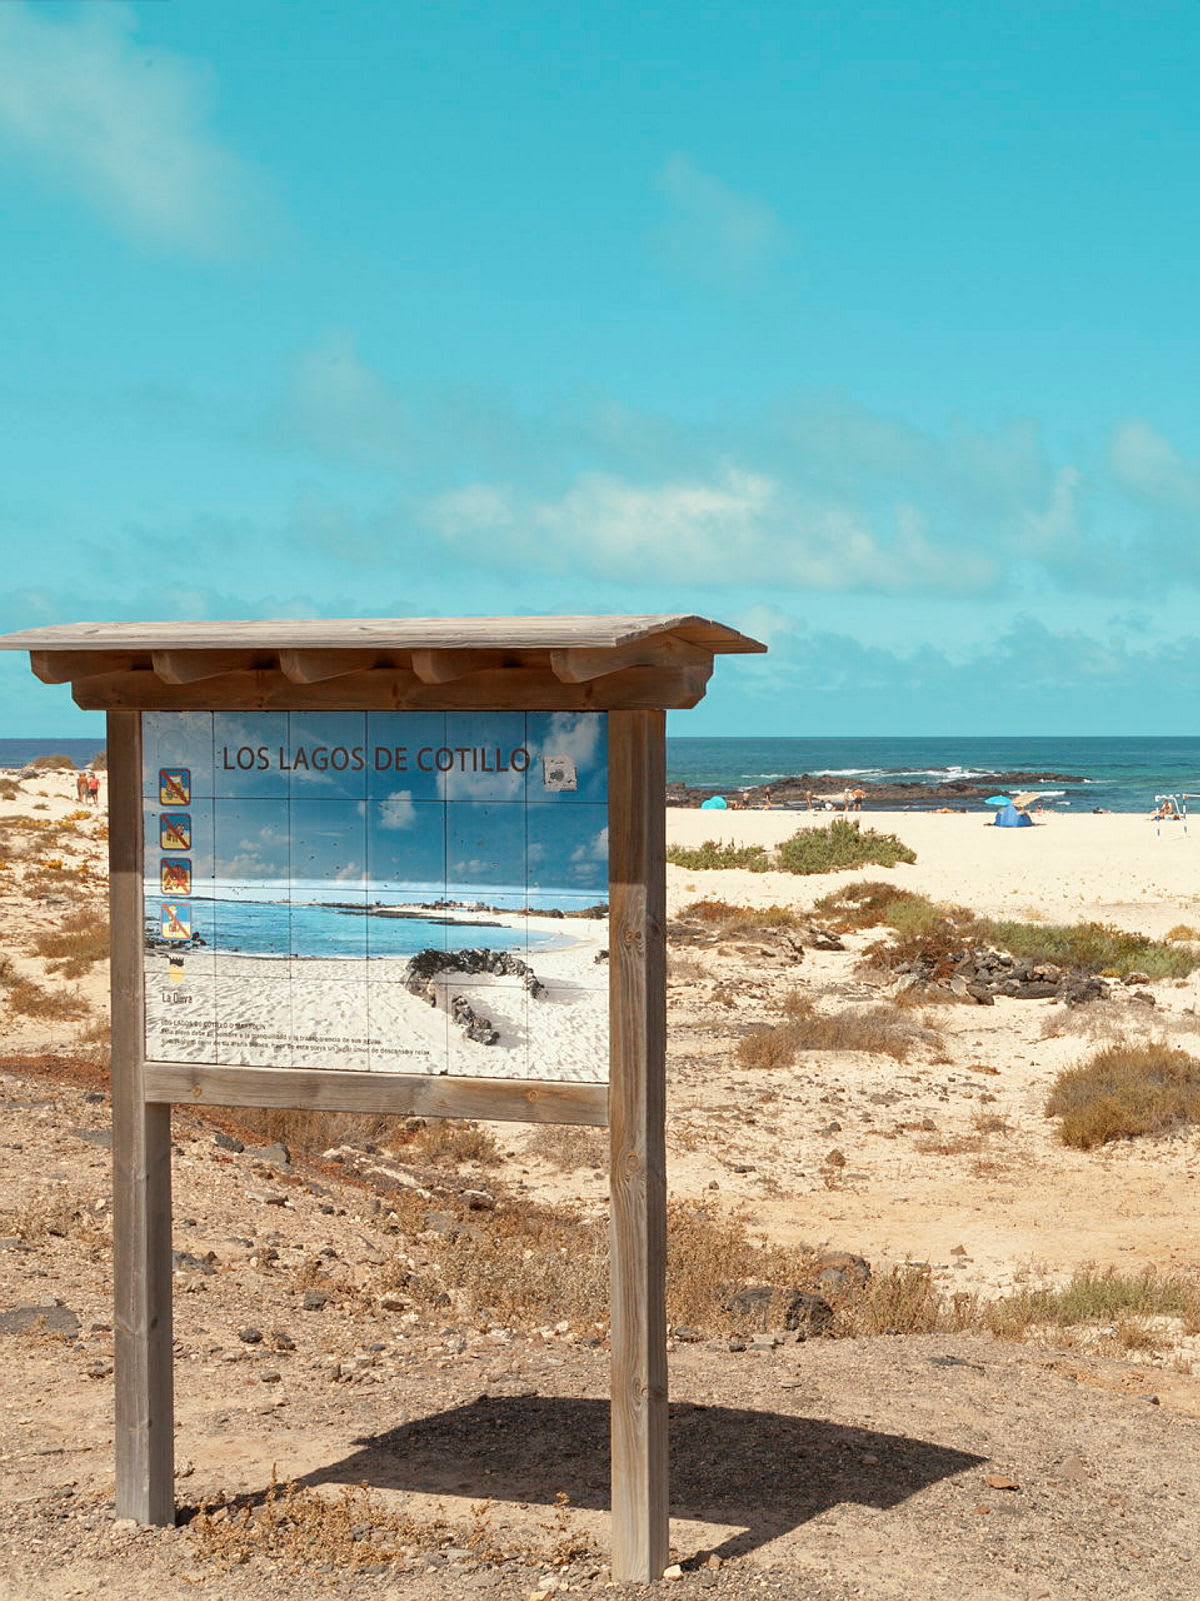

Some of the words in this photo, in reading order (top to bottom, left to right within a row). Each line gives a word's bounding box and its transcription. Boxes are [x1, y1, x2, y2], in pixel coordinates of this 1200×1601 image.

[223, 746, 270, 771] LOS
[279, 746, 365, 771] LAGOS
[374, 746, 408, 772] DE
[416, 747, 530, 772] COTILLO
[162, 992, 171, 1003] La
